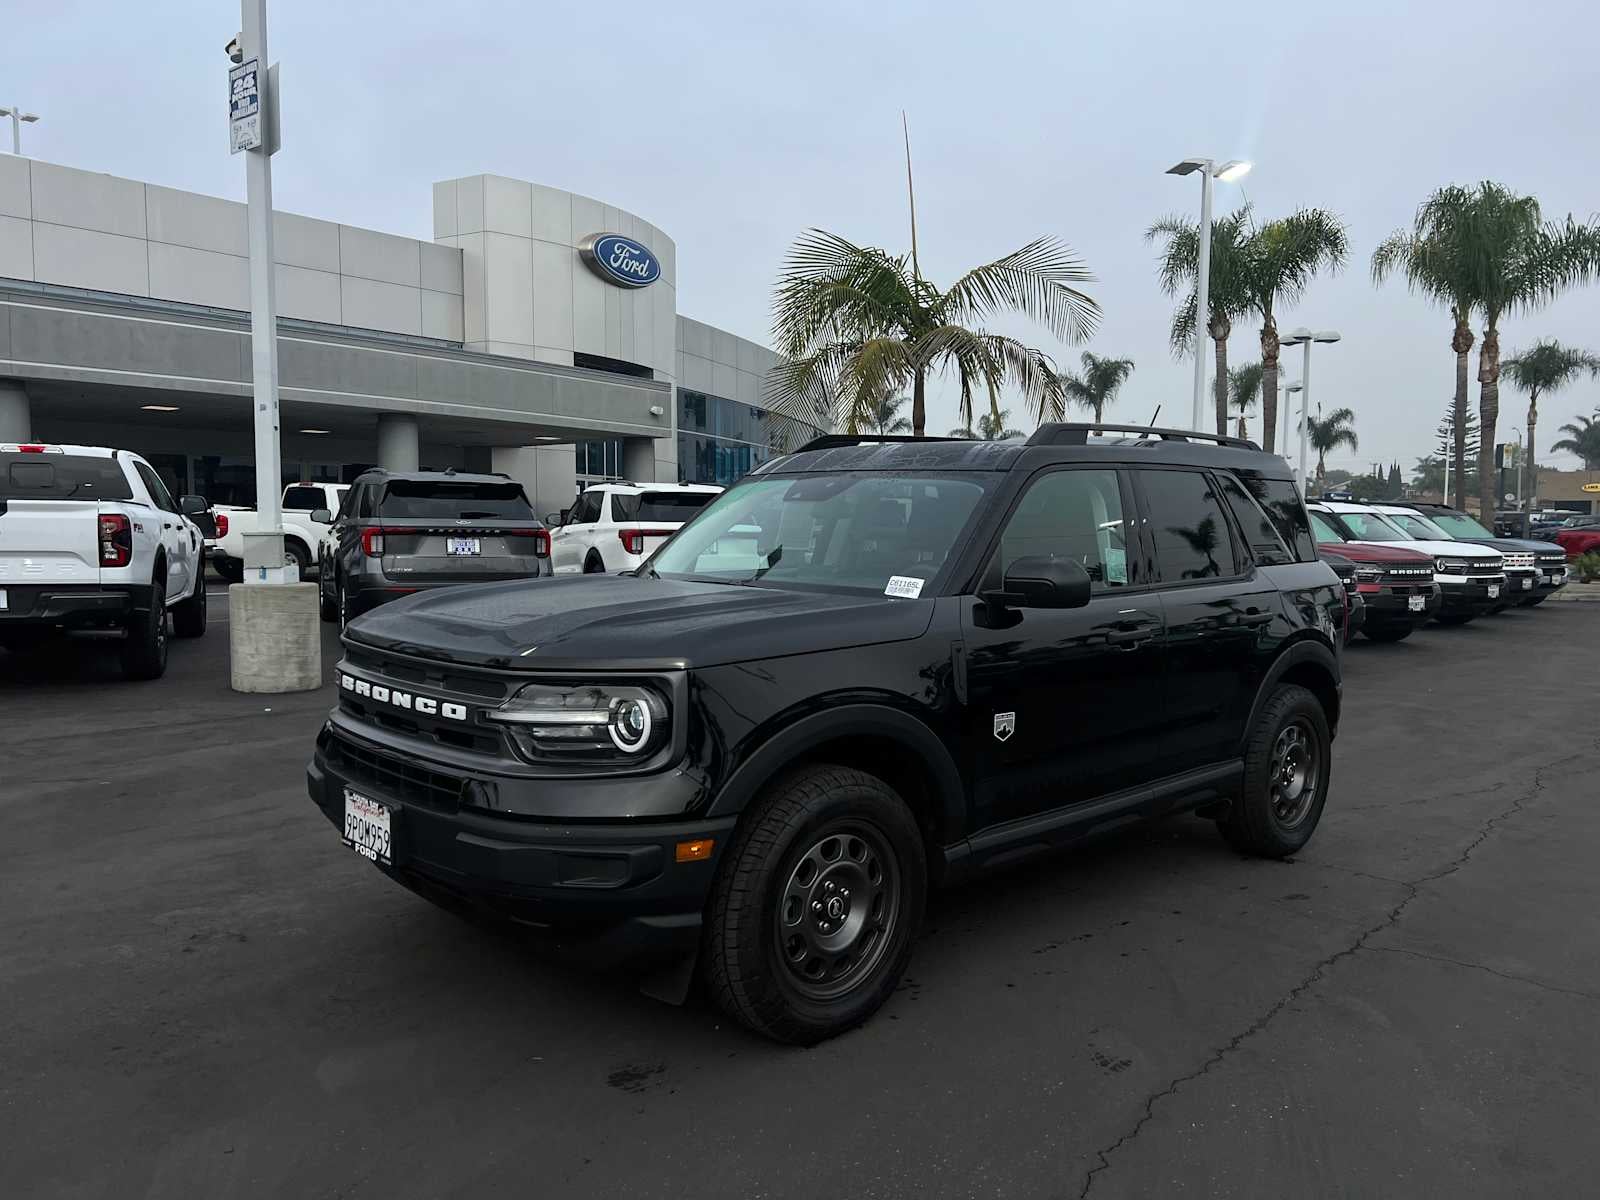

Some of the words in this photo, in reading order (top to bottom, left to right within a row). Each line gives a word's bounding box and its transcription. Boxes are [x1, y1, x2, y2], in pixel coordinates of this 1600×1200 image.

[610, 243, 650, 278] Ford
[341, 674, 467, 720] BRONCO
[355, 842, 377, 861] FORD
